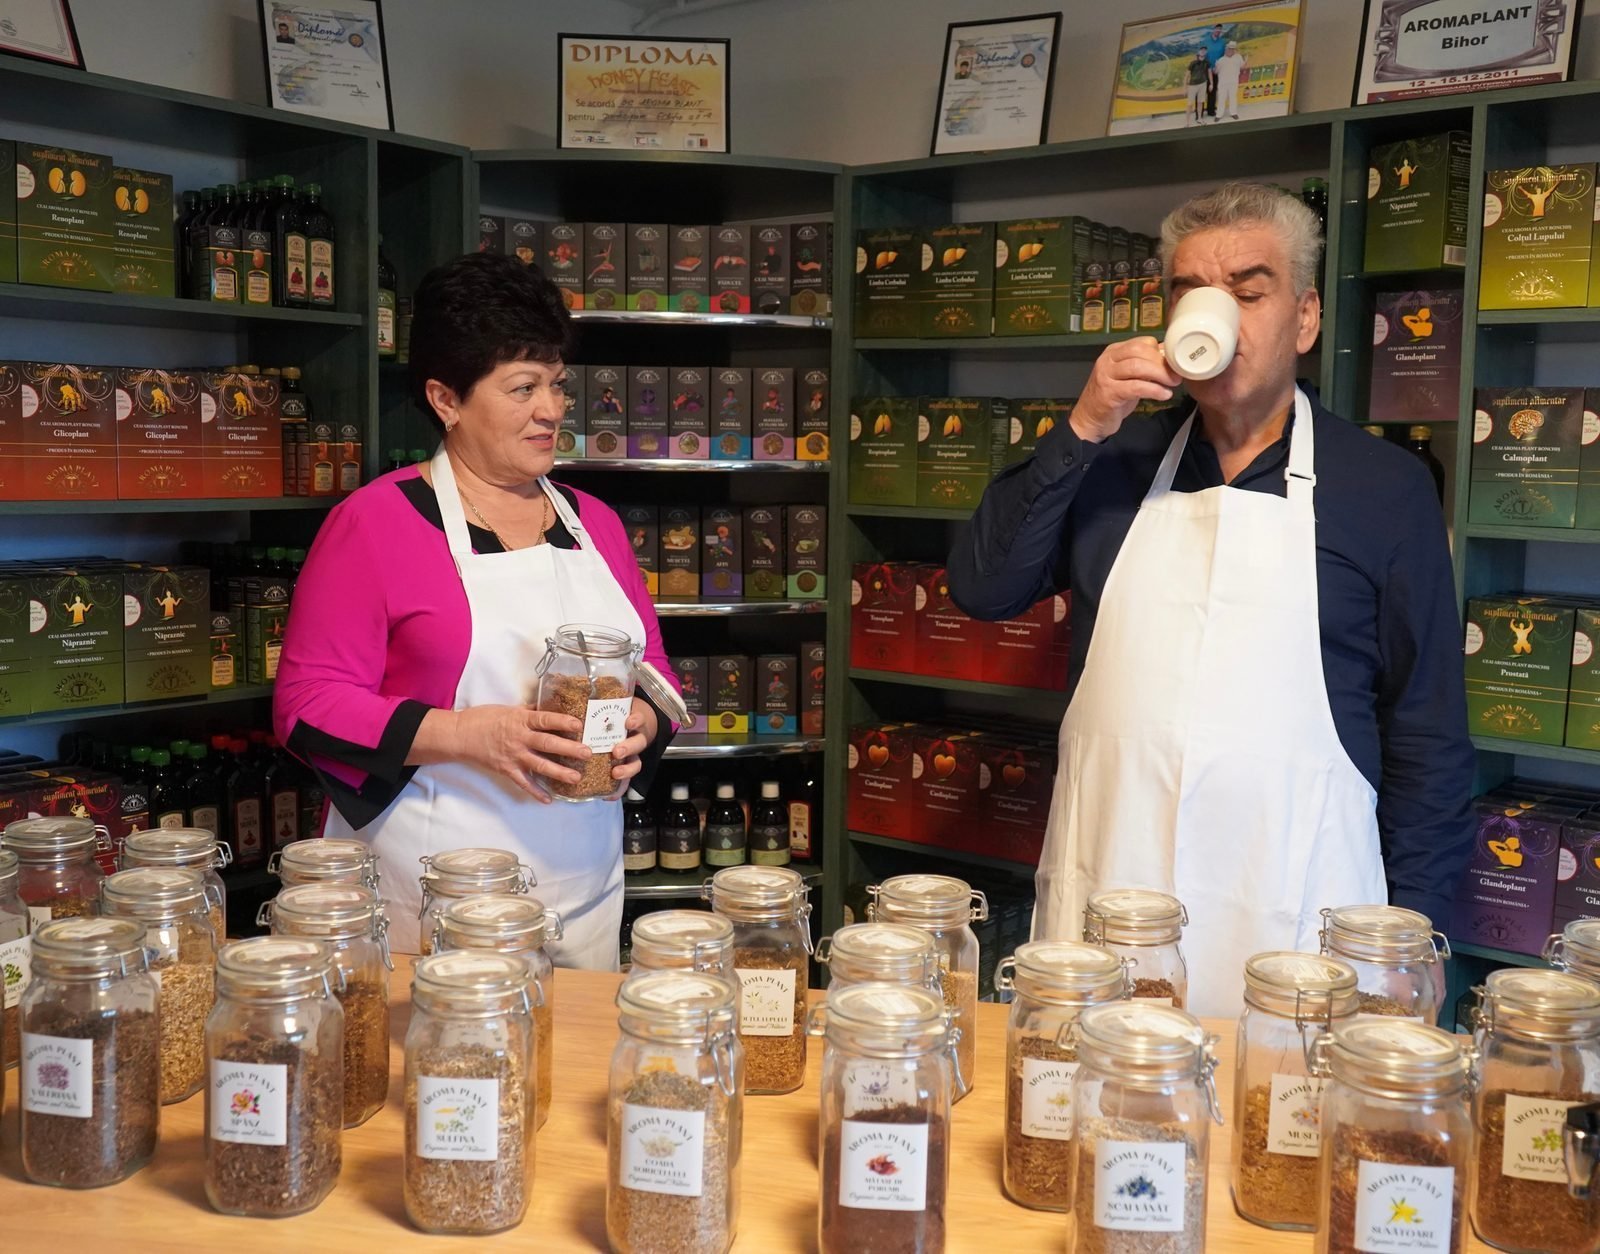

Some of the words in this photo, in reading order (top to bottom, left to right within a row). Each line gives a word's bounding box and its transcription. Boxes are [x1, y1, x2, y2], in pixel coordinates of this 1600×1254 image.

[1404, 5, 1532, 34] AROMAPLANT
[1440, 34, 1489, 50] Bihor
[570, 44, 718, 66] DIPLOMA
[1409, 80, 1426, 88] 12
[1440, 69, 1519, 85] 15.12.2011
[576, 99, 586, 107] Se
[568, 112, 596, 122] pentru
[52, 214, 84, 224] Renoplant
[118, 230, 148, 240] Renoplant
[1507, 232, 1532, 242] Colțul
[1534, 232, 1565, 242] Lupului
[1396, 353, 1436, 362] Glandoplant
[53, 429, 89, 440] Glicoplant
[145, 431, 178, 441] Glicoplant
[228, 432, 258, 442] Glicoplant
[1502, 453, 1548, 464] Calmoplant
[154, 632, 186, 640] Năpraznic
[62, 638, 96, 648] Năpraznic
[1500, 668, 1529, 678] Prostată
[1480, 877, 1526, 892] Glandoplant
[1028, 1070, 1060, 1087] AROMA
[1278, 1084, 1312, 1104] AROMA
[1512, 1107, 1550, 1124] AROMA
